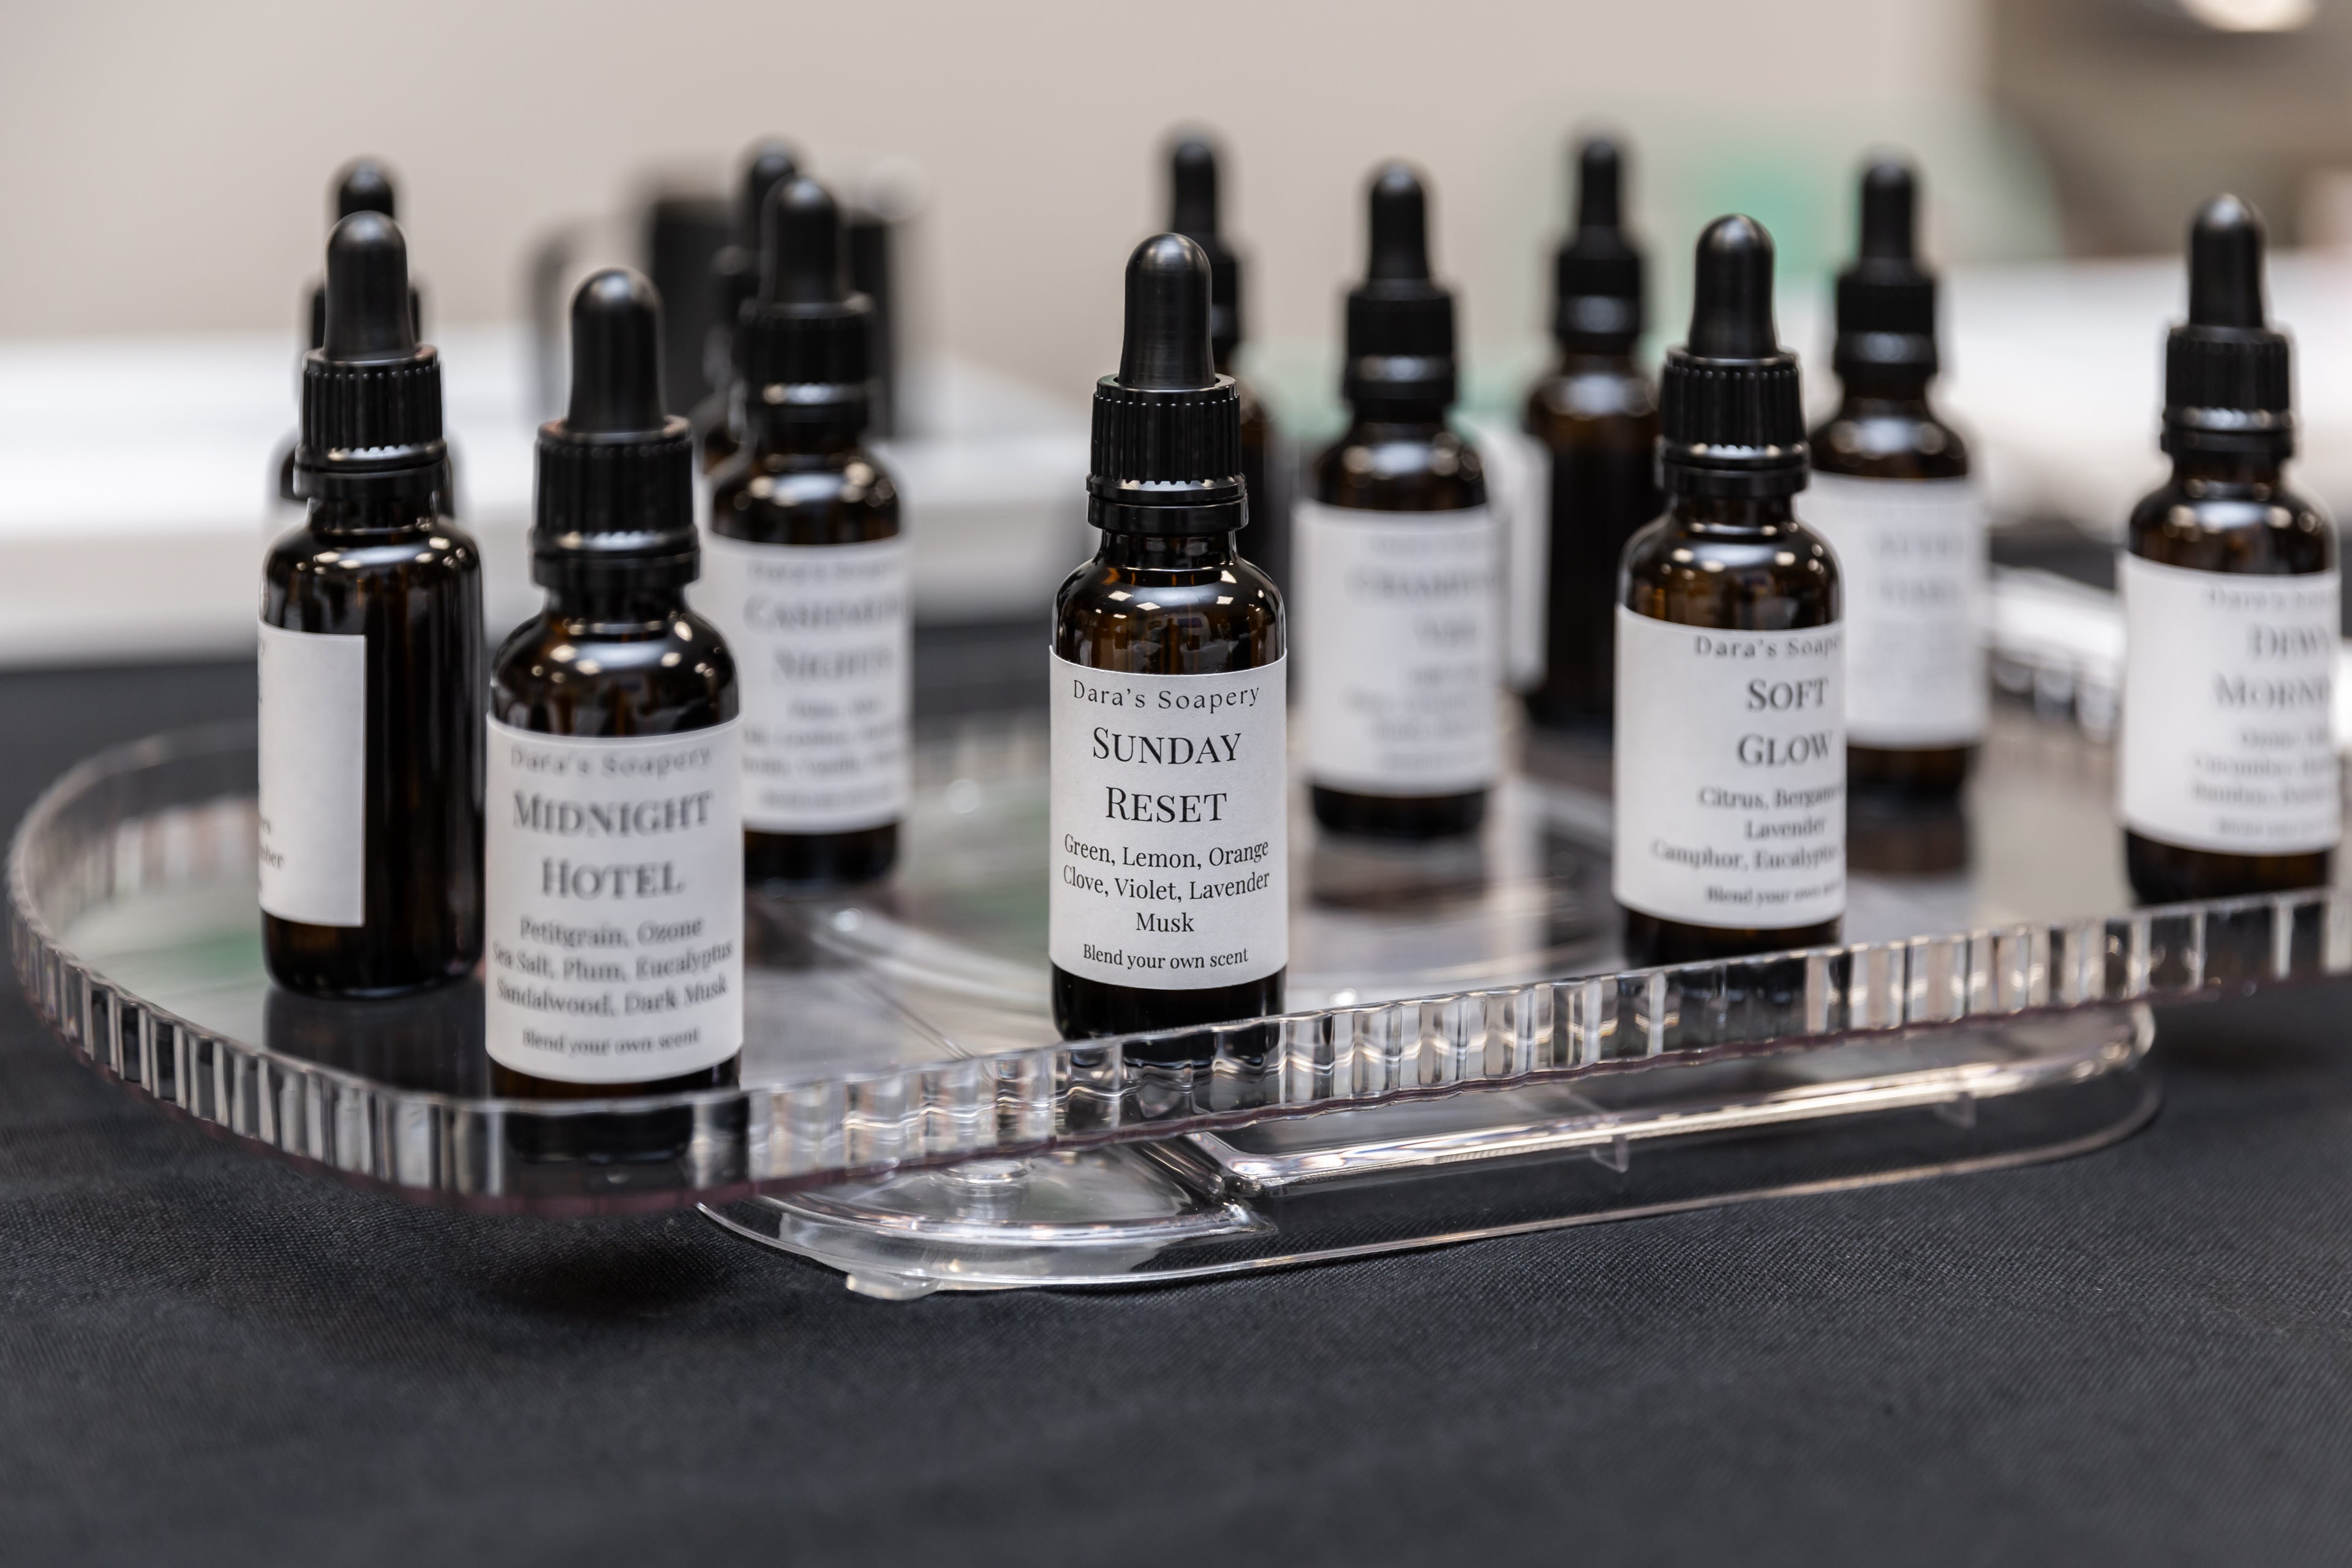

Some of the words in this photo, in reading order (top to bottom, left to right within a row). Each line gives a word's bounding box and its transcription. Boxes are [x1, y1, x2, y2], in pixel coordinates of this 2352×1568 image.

[1694, 635, 1777, 658] Dara's
[1073, 679, 1145, 709] Dara's
[1158, 687, 1259, 714] Soapery
[1747, 677, 1830, 713] SOFT
[510, 744, 594, 777] Dara's
[600, 745, 712, 781] Soapery
[1092, 726, 1242, 765] SUNDAY
[1736, 729, 1833, 768] GLOW
[513, 789, 715, 837] MIDNIGHT
[1105, 786, 1227, 823] RESET
[1697, 786, 1769, 811] Citrus,
[1064, 834, 1116, 867] Green,
[1121, 846, 1202, 870] Lemon,
[1208, 841, 1269, 866] Orange
[1651, 840, 1751, 872] Camphor,
[541, 856, 686, 901] HOTEL
[1063, 864, 1109, 897] Clove,
[1114, 877, 1182, 903] Violet,
[1189, 871, 1270, 900] Lavender
[1704, 884, 1754, 907] Blend
[519, 917, 630, 949] Petitgrain,
[636, 916, 704, 948] Ozone
[1135, 911, 1195, 933] Musk
[492, 941, 513, 966] Sea
[517, 946, 555, 980] Salt,
[562, 957, 628, 982] Plum,
[635, 939, 734, 980] Eucalyptus
[1083, 943, 1123, 966] Blend
[1127, 954, 1166, 970] your
[1169, 955, 1205, 970] own
[1209, 948, 1249, 968] scent
[496, 978, 617, 1017] Sandalwood,
[624, 986, 677, 1017] Dark
[684, 972, 727, 1006] Musk
[522, 1027, 564, 1054] Blend
[568, 1037, 611, 1058] your
[614, 1037, 654, 1053] own
[656, 1026, 701, 1051] scent
